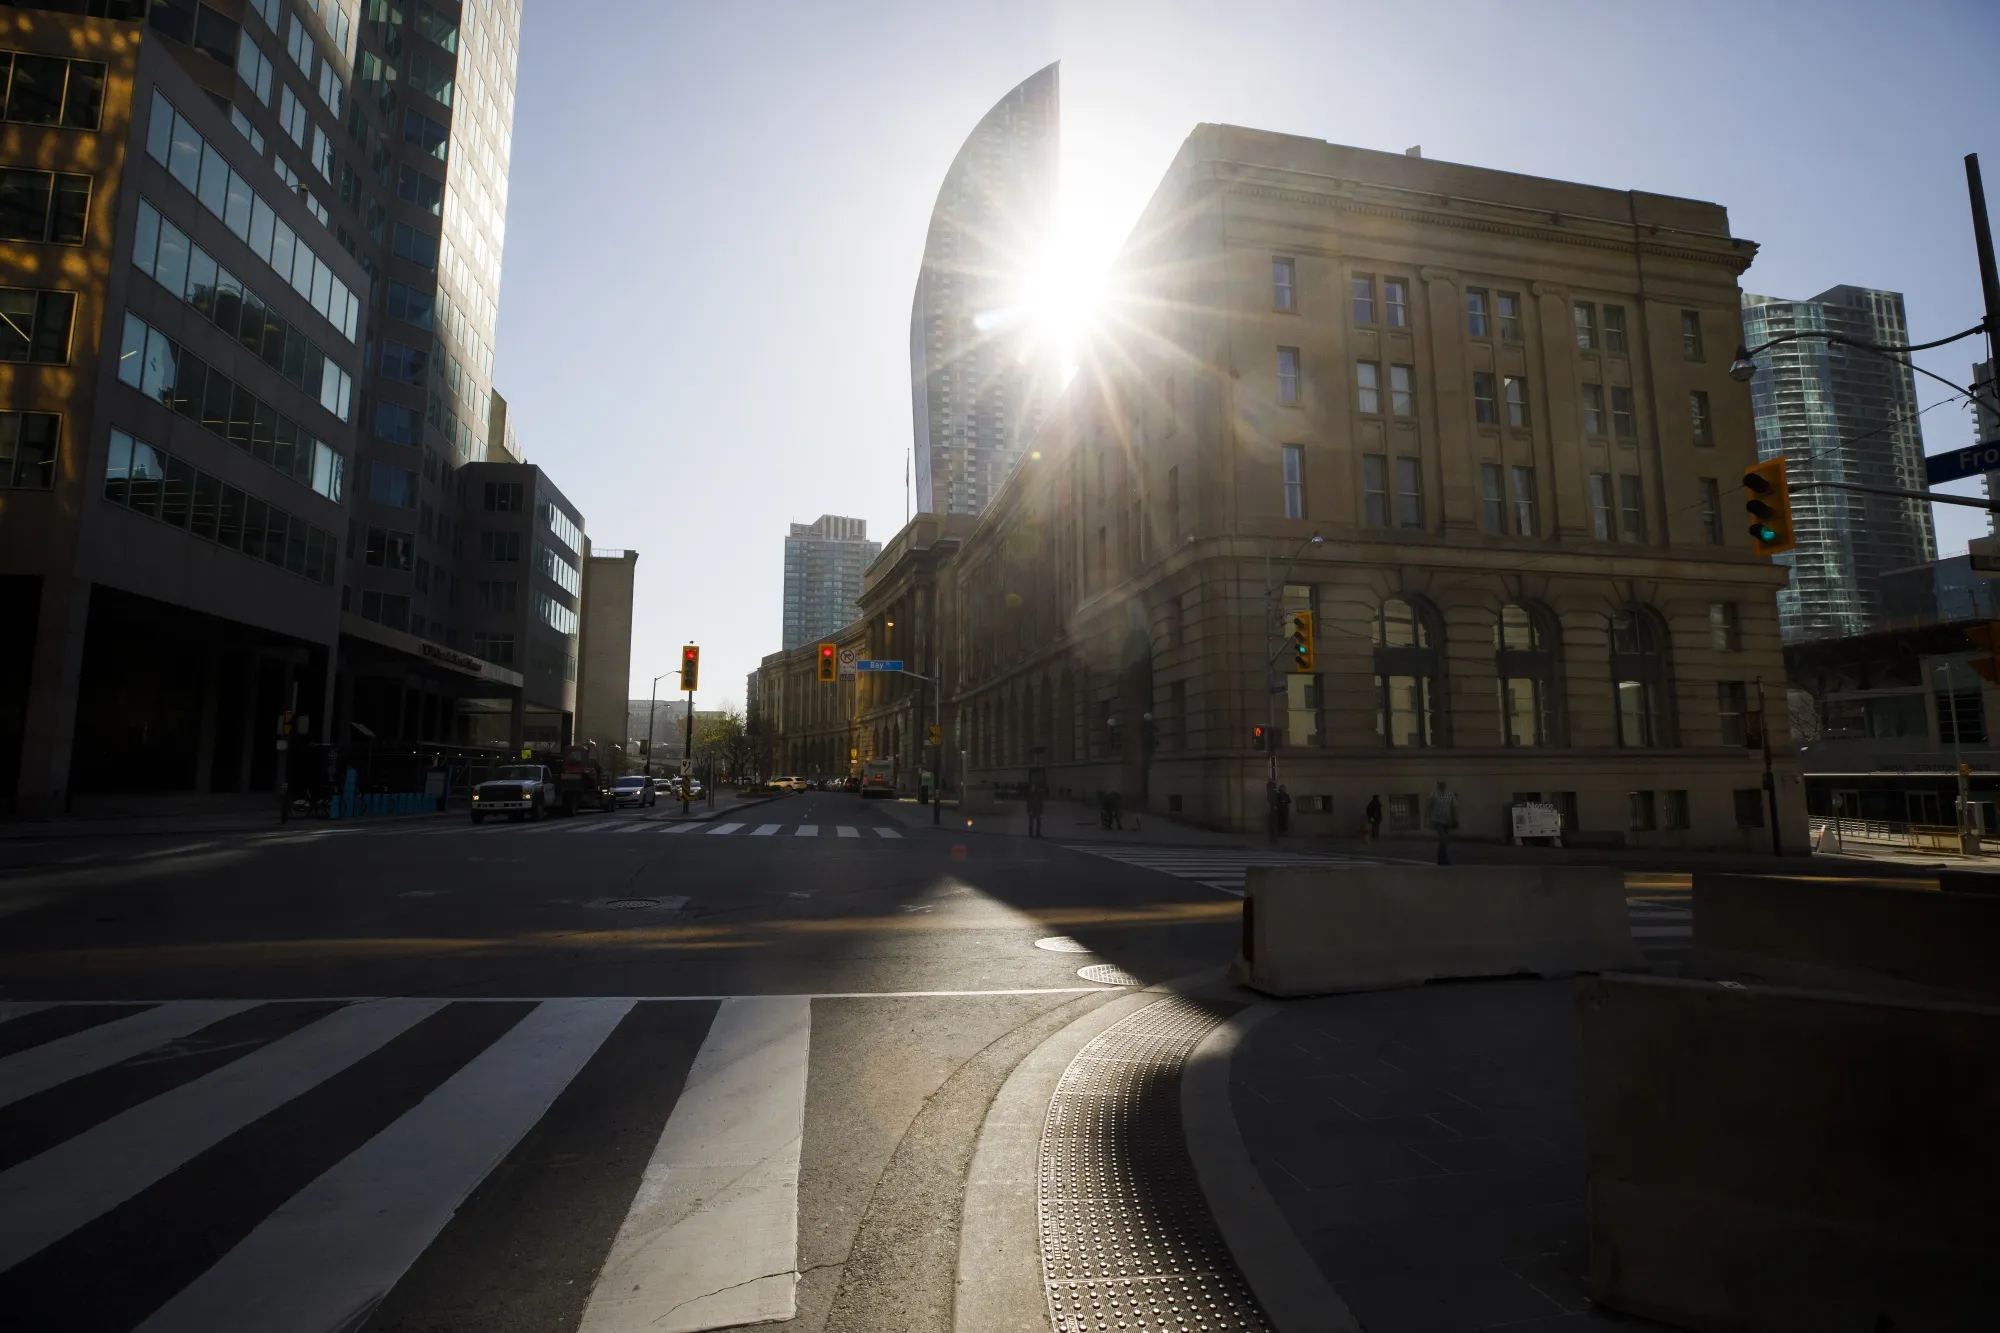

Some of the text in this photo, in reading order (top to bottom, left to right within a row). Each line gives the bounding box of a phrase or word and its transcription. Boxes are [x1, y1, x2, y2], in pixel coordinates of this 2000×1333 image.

[1960, 448, 1999, 470] Fro
[870, 661, 884, 670] Bay
[1526, 801, 1554, 810] Notice
